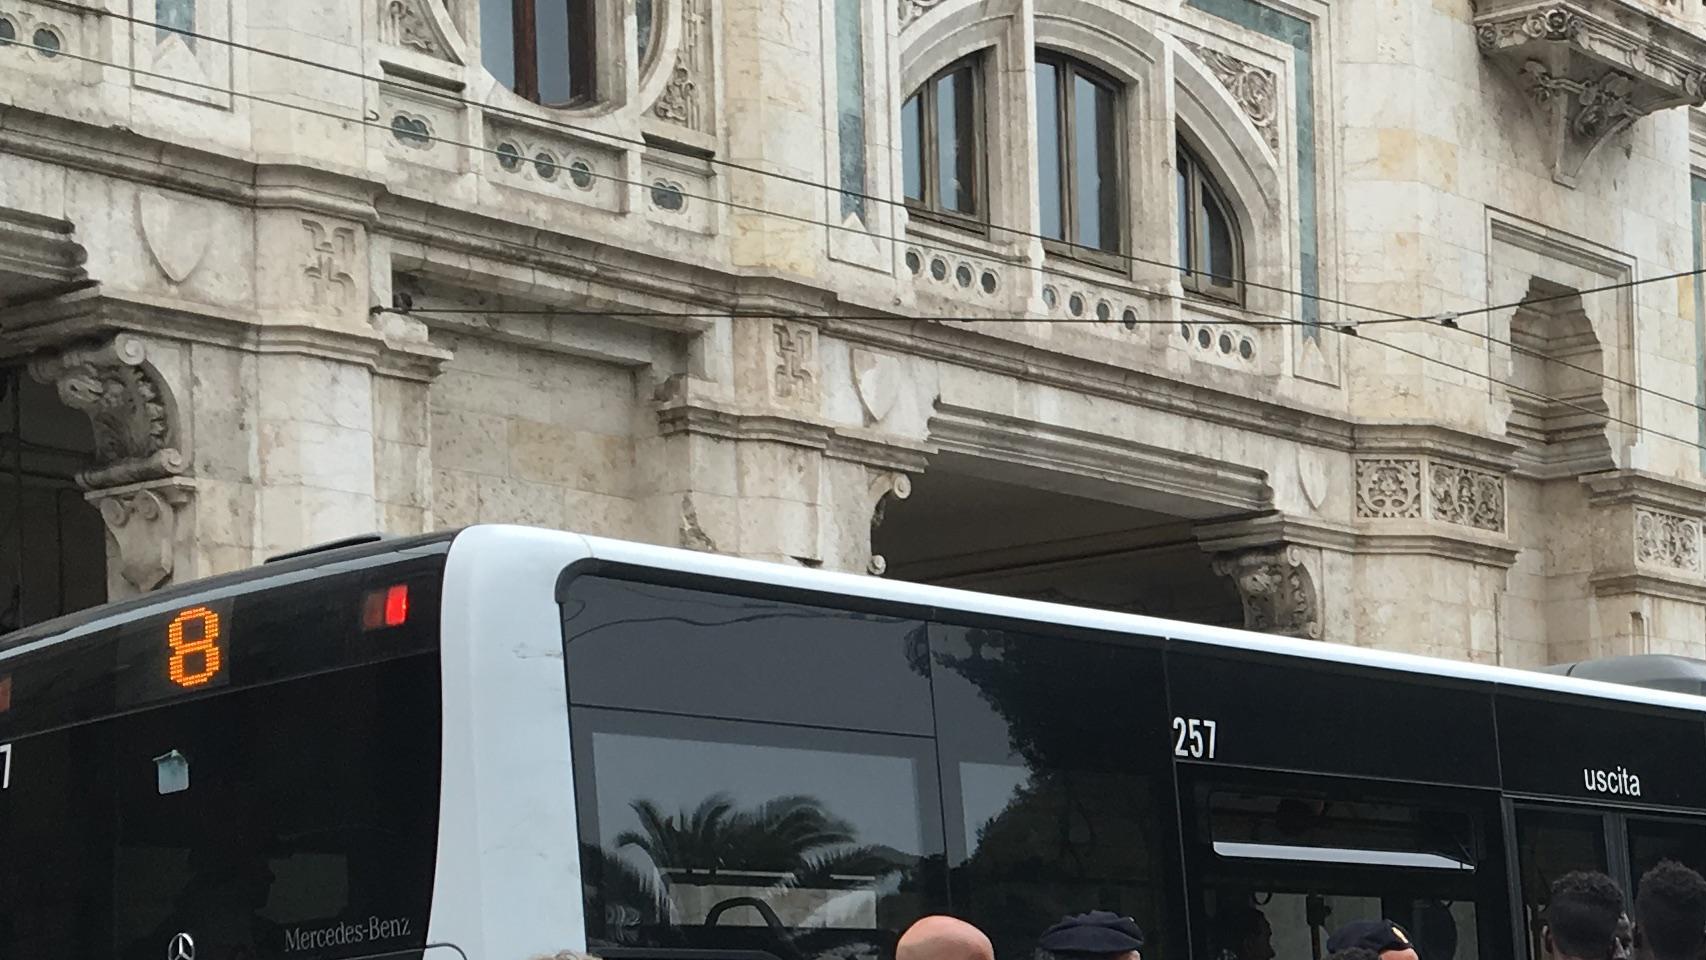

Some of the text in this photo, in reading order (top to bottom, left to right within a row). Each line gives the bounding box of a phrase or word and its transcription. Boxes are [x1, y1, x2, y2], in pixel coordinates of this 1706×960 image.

[168, 606, 219, 688] 8
[1173, 716, 1216, 759] 257
[1584, 765, 1641, 797] uscita
[284, 915, 412, 952] Mercedes-Benz
